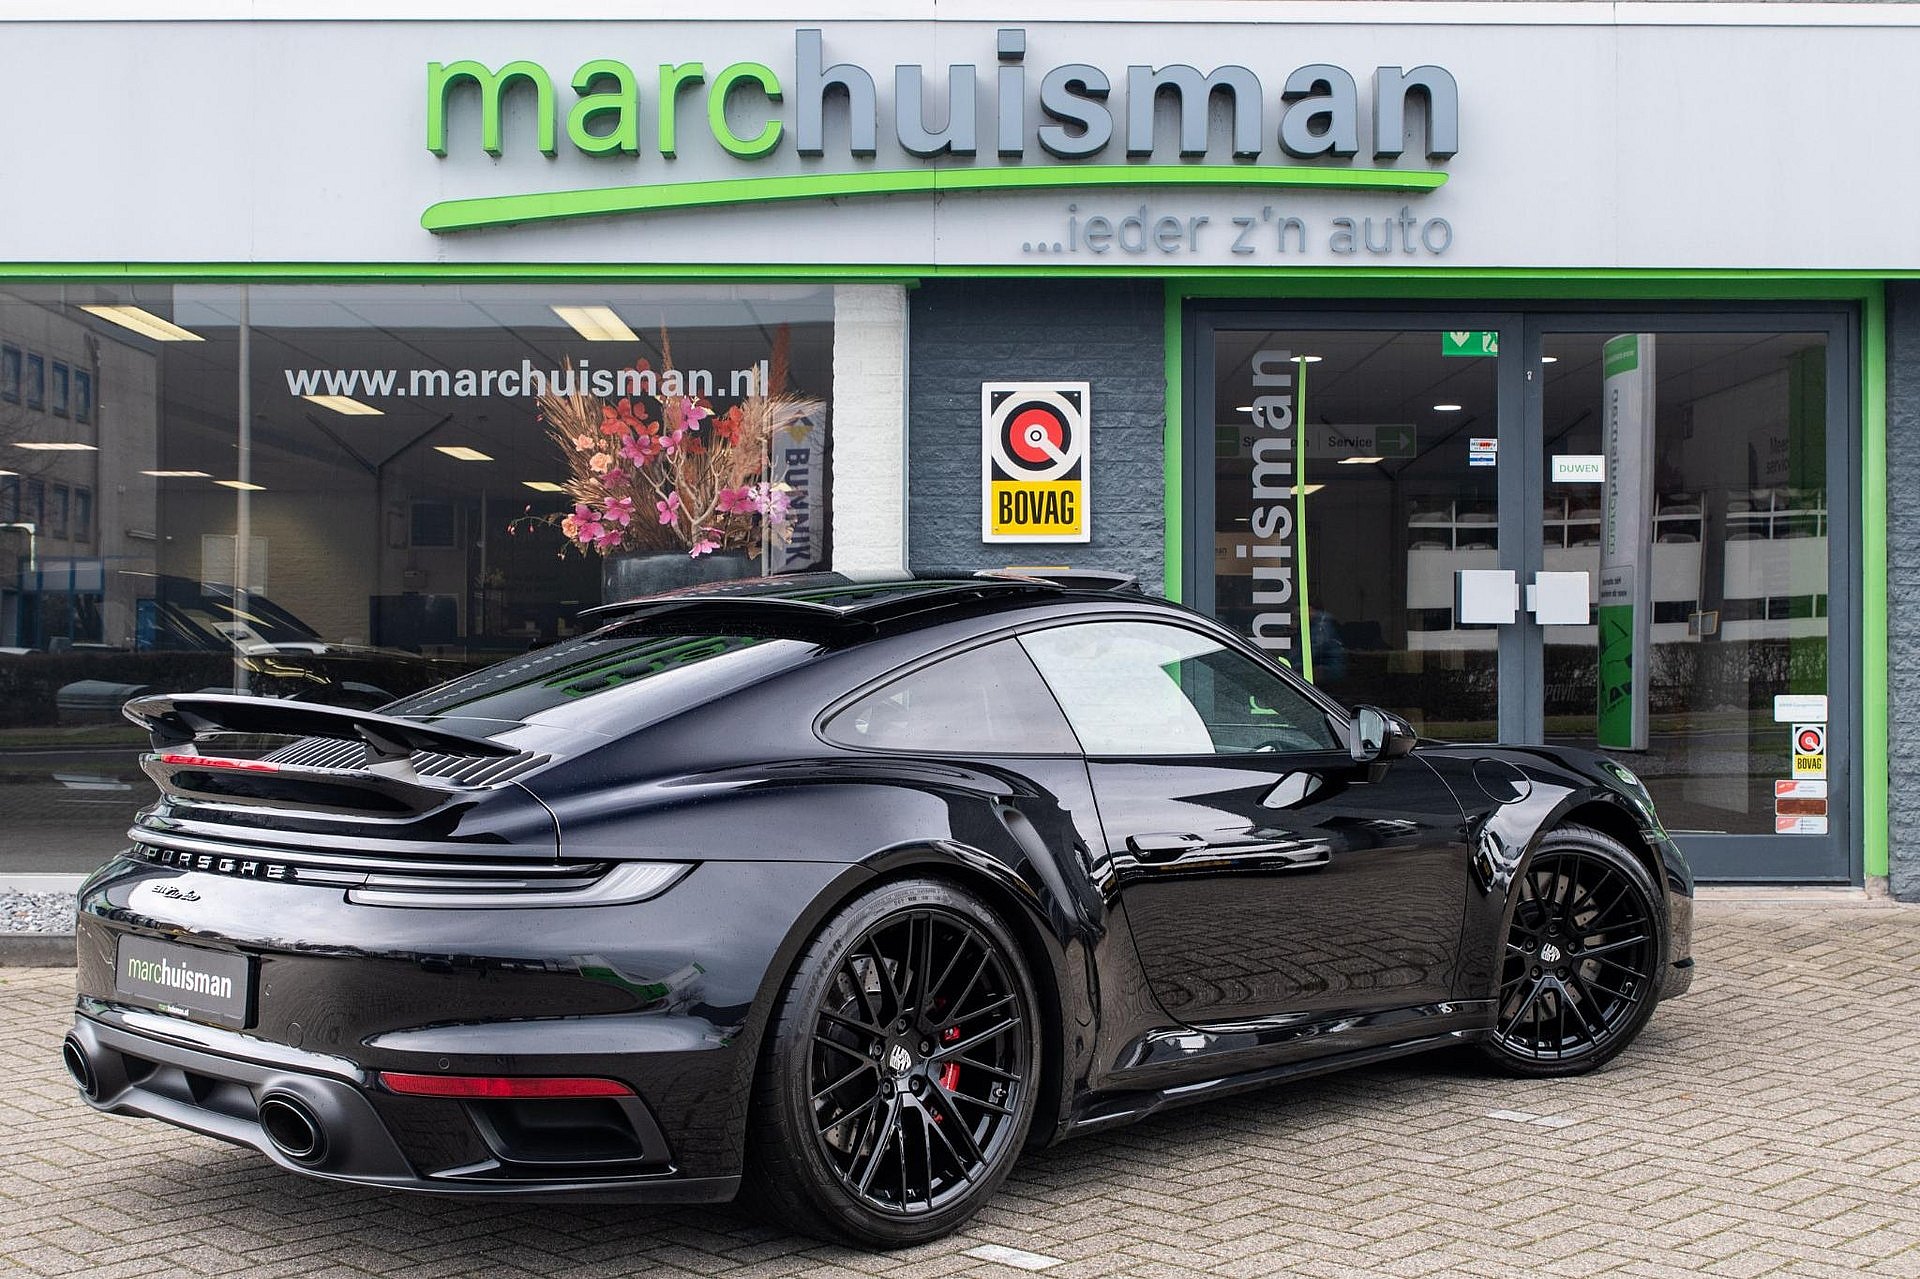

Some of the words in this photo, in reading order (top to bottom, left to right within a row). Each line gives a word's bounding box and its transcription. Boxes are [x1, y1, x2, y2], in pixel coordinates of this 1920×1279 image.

[426, 28, 1459, 161] marchuisman
[1230, 205, 1307, 254] z'n
[1328, 205, 1453, 255] auto
[284, 359, 770, 398] www.marchuisman.nl
[1328, 436, 1373, 448] Service
[1559, 464, 1599, 473] DUWEN
[999, 490, 1075, 525] BOVAG
[1797, 757, 1822, 770] BOVAG
[144, 847, 287, 879] PORSCHE
[127, 957, 233, 999] marchuisman
